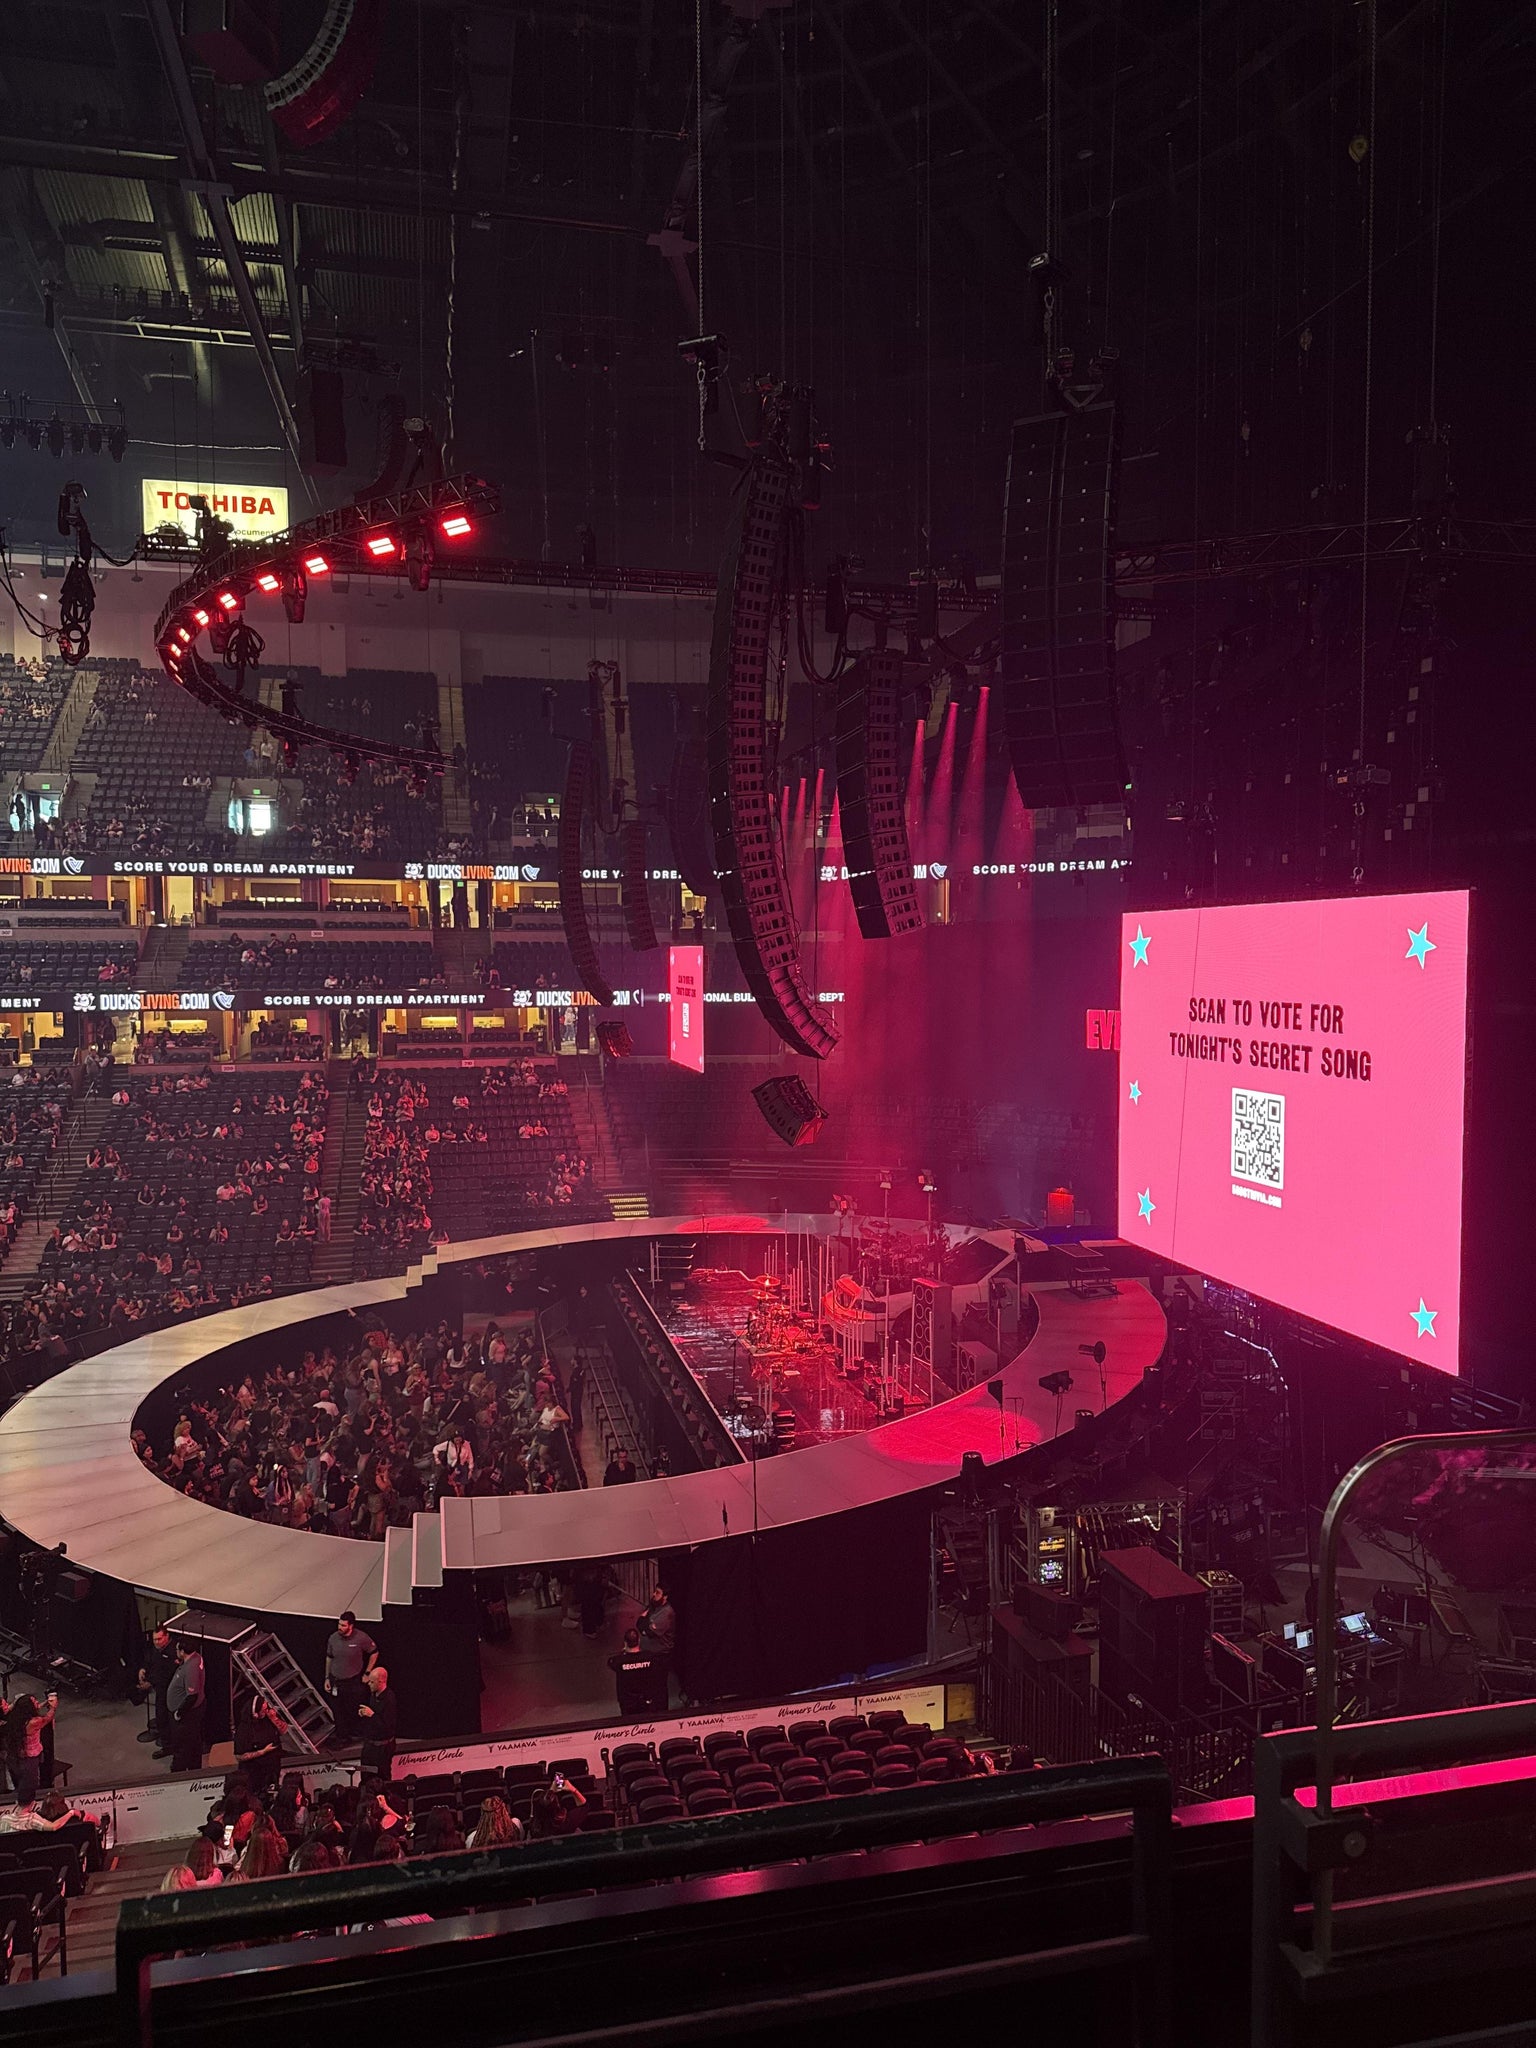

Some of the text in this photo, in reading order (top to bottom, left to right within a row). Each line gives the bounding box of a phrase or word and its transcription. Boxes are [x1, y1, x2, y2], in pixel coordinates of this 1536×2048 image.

[157, 491, 275, 515] TOHIBA
[114, 861, 355, 875] SCORE YOUR DREAM APARTMENT
[427, 864, 519, 880] DUCKSLIVING.COM
[972, 864, 1016, 875] SCORE
[1060, 860, 1105, 871] DREAM
[100, 993, 209, 1010] DUCKSLIVING.COM
[264, 994, 485, 1006] SCORE YOUR DREAM APARTMENT
[819, 992, 846, 1003] SEPT.
[1189, 997, 1344, 1034] SCAN TO VOTE FOR
[1169, 1032, 1372, 1081] TONIGHT'S SECRET SONG
[622, 1661, 650, 1671] SECURITY
[778, 1701, 836, 1718] Winner's Circle
[594, 1724, 656, 1741] Winner's Circle
[397, 1748, 464, 1766] Winner's Circle
